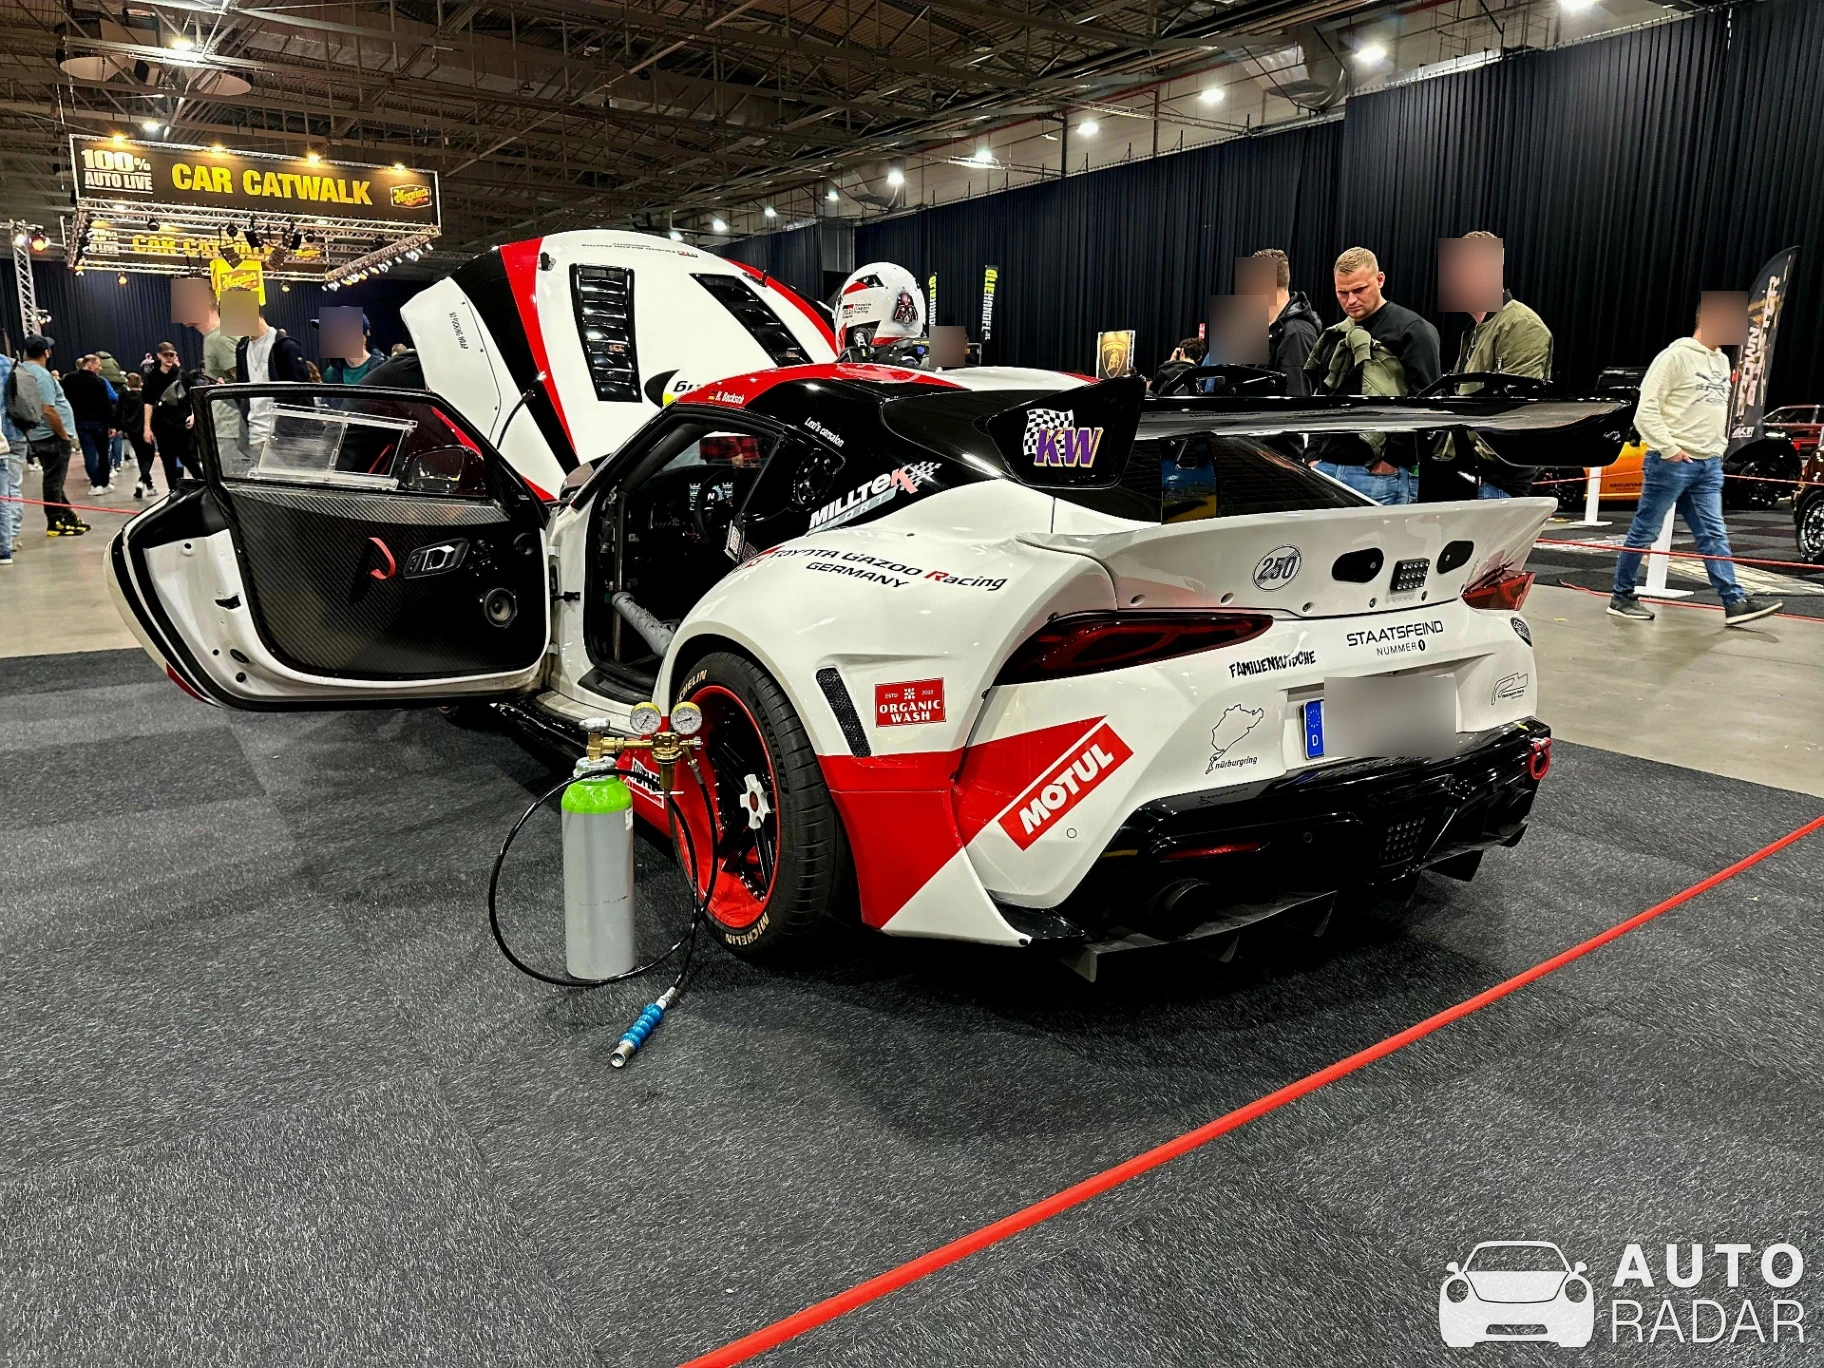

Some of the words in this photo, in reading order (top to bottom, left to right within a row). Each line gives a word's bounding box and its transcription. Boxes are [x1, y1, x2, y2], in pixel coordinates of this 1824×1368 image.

[81, 149, 151, 172] 100%
[85, 171, 124, 188] AUTO
[125, 175, 153, 190] LIVE
[172, 163, 233, 193] CAR
[243, 170, 373, 205] CATWALK
[1033, 427, 1104, 468] KW
[805, 561, 911, 588] GERMANY
[841, 552, 923, 577] GAZOO
[924, 570, 1009, 592] Racing
[1257, 556, 1299, 582] 250
[1346, 620, 1444, 647] STAATSFEIND
[1376, 642, 1417, 656] NUMMER
[879, 699, 941, 714] ORGANIC
[890, 710, 931, 723] WASH
[1311, 733, 1319, 746] D
[1017, 742, 1115, 835] MOTUL
[725, 911, 769, 946] MICHELIN
